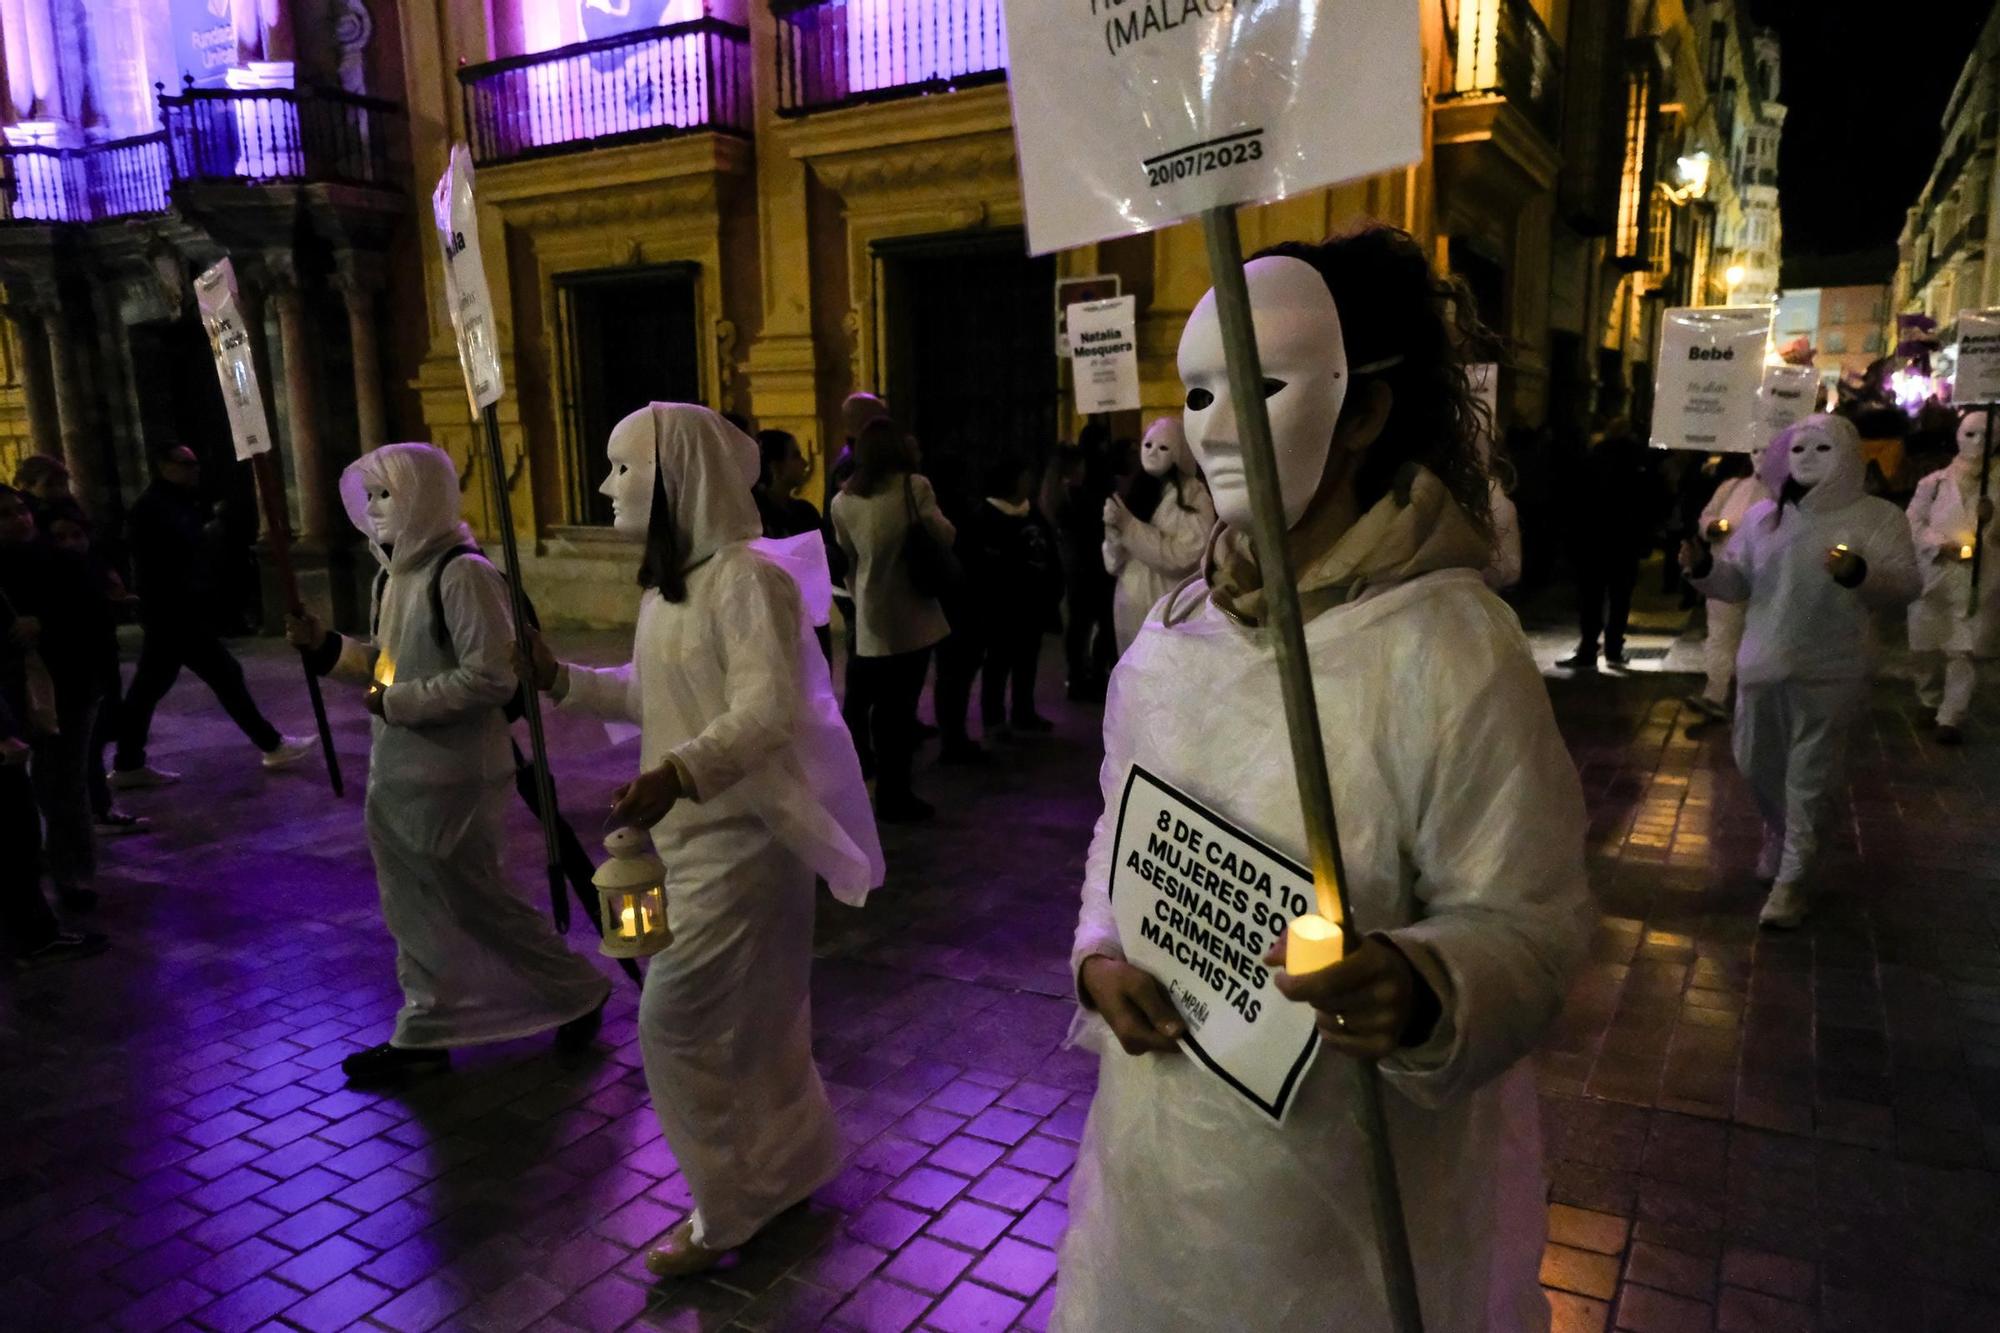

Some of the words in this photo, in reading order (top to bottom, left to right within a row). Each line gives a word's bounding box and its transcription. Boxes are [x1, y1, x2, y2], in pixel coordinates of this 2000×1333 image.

[1148, 140, 1263, 187] 20/07/2023
[1080, 328, 1122, 344] Natalia
[1688, 346, 1734, 361] Bebé
[1126, 850, 1264, 956] ASESINADAS
[1147, 832, 1249, 914] MUJERES
[1157, 810, 1171, 832] 8
[1173, 819, 1203, 854] DE
[1206, 841, 1271, 899] CADA
[1280, 885, 1307, 917] 10
[1140, 916, 1262, 1024] MACHISTAS
[1155, 899, 1269, 990] CRÍMENES
